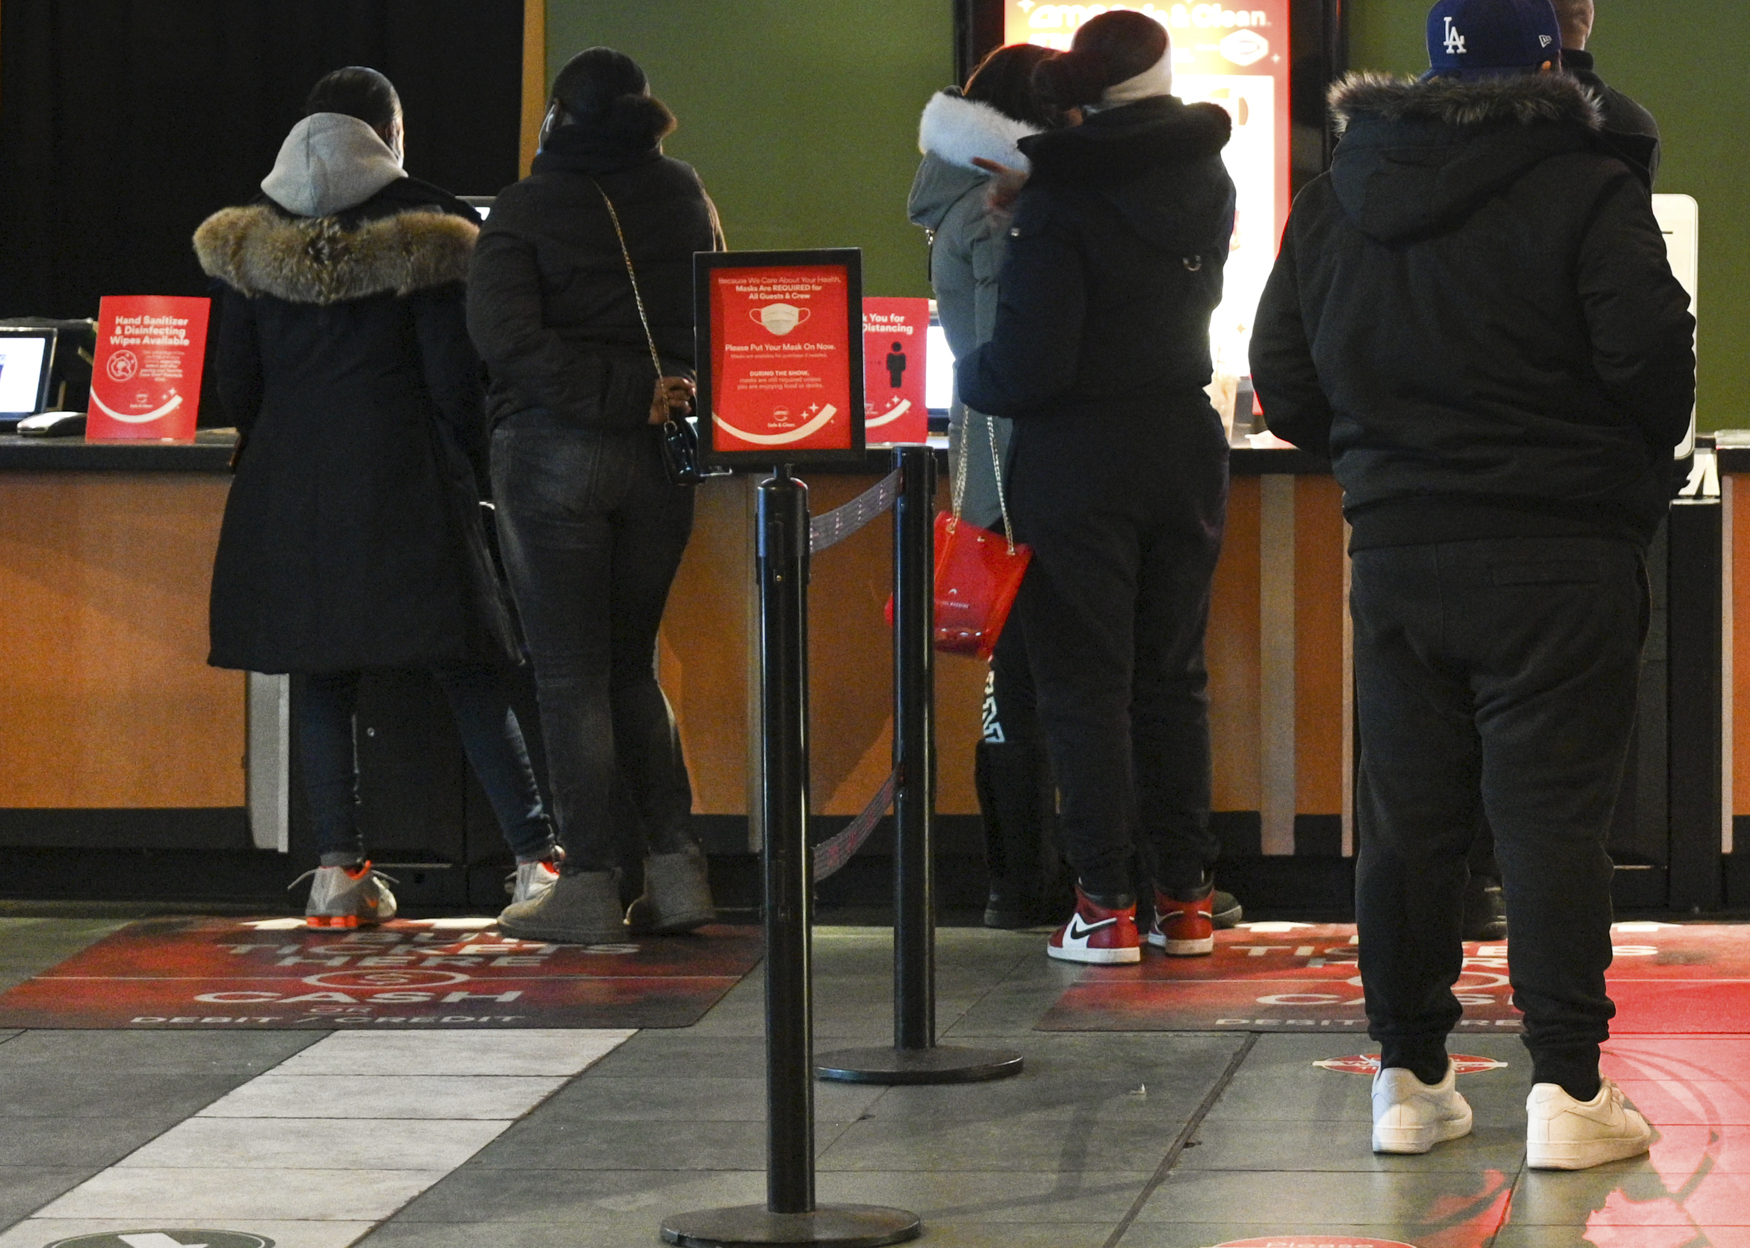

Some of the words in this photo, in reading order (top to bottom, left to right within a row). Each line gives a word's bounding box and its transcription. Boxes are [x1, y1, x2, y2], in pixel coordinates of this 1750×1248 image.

[1443, 17, 1467, 54] LA
[115, 315, 141, 325] Hand
[143, 315, 189, 326] Sanitizer
[870, 313, 888, 323] You
[890, 313, 905, 323] for
[115, 325, 122, 335] &
[124, 325, 186, 339] Disinfecting
[110, 336, 141, 347] Wipes
[142, 335, 190, 346] Available
[218, 943, 640, 954] TICKETS
[275, 955, 551, 967] HERE
[193, 990, 525, 1004] CASH
[334, 1015, 525, 1023] CREDIT
